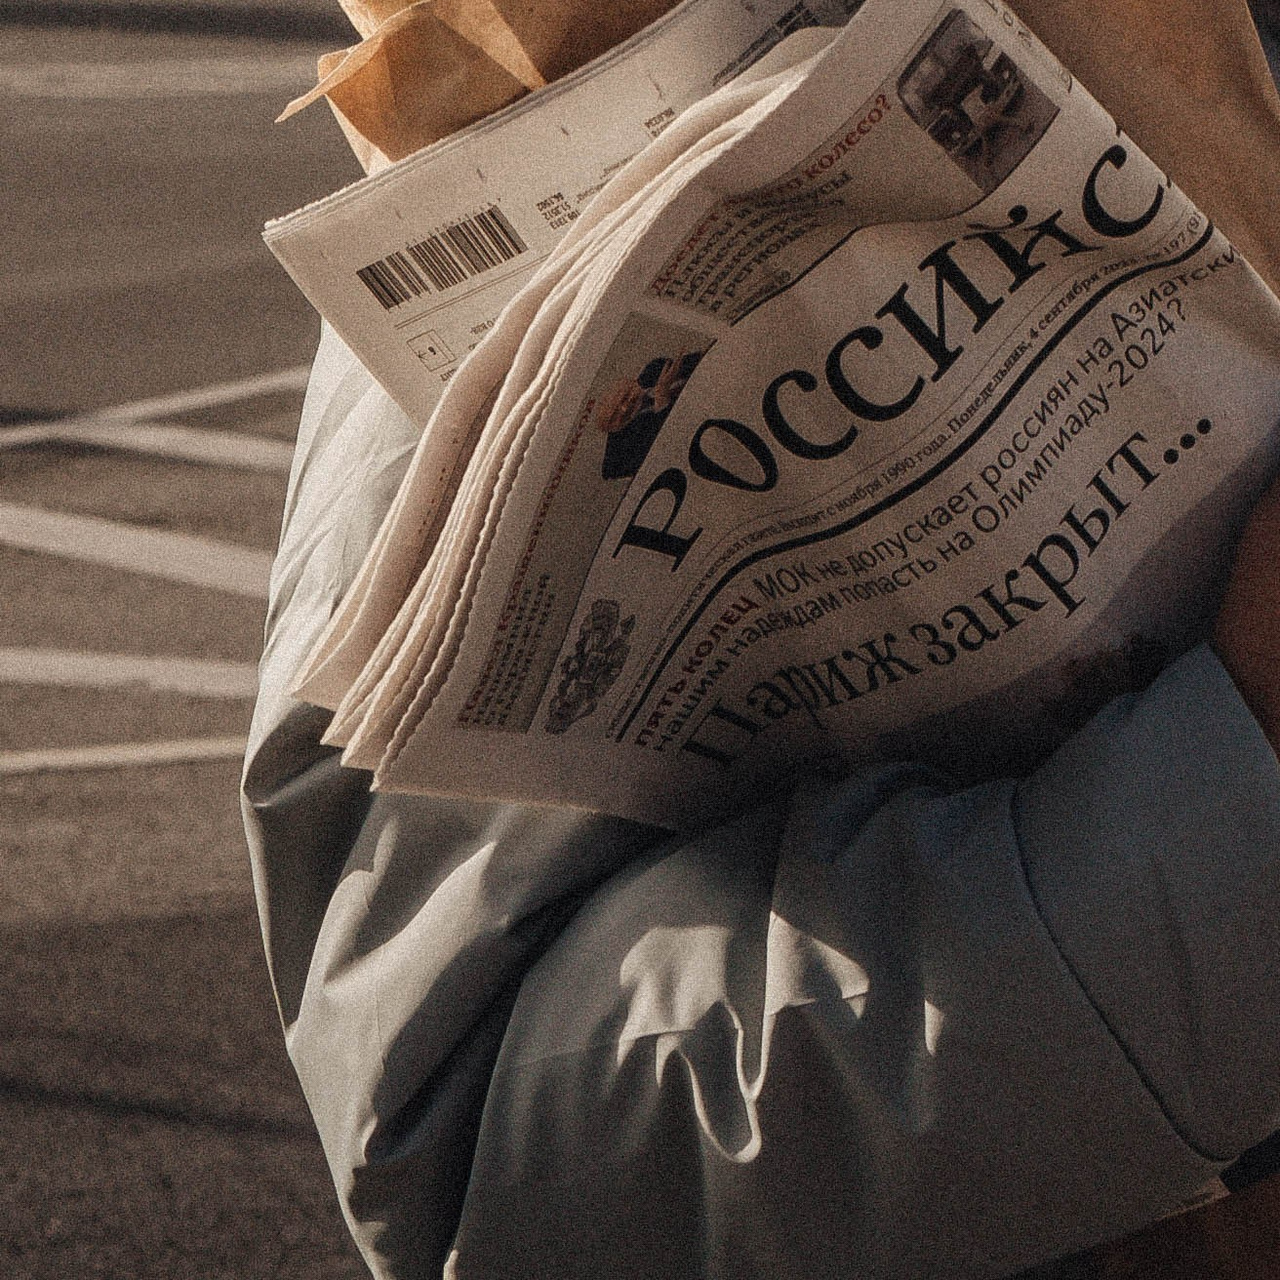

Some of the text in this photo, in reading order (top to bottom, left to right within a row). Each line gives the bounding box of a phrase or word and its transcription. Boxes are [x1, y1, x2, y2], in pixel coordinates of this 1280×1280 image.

[803, 94, 892, 178] колесо?
[612, 128, 1171, 572] РОССИЙС
[656, 297, 1187, 751] нашим надеждам попасть на Олимпиаду-2024?
[825, 506, 836, 516] с
[835, 478, 882, 512] ноября
[881, 456, 916, 484] 1990
[915, 435, 951, 462] года.
[946, 341, 1033, 433] Понедельник,
[1027, 327, 1040, 341] 4
[1037, 272, 1100, 331] сентября
[636, 678, 688, 746] ПЯТЬ
[683, 598, 759, 675] КОЛЕЦ
[753, 561, 820, 601] МОК
[817, 559, 846, 581] не
[849, 481, 978, 582] допускает
[980, 372, 1079, 494] россиян
[1081, 335, 1115, 376] на
[681, 417, 1213, 765] Париж закрыт...
